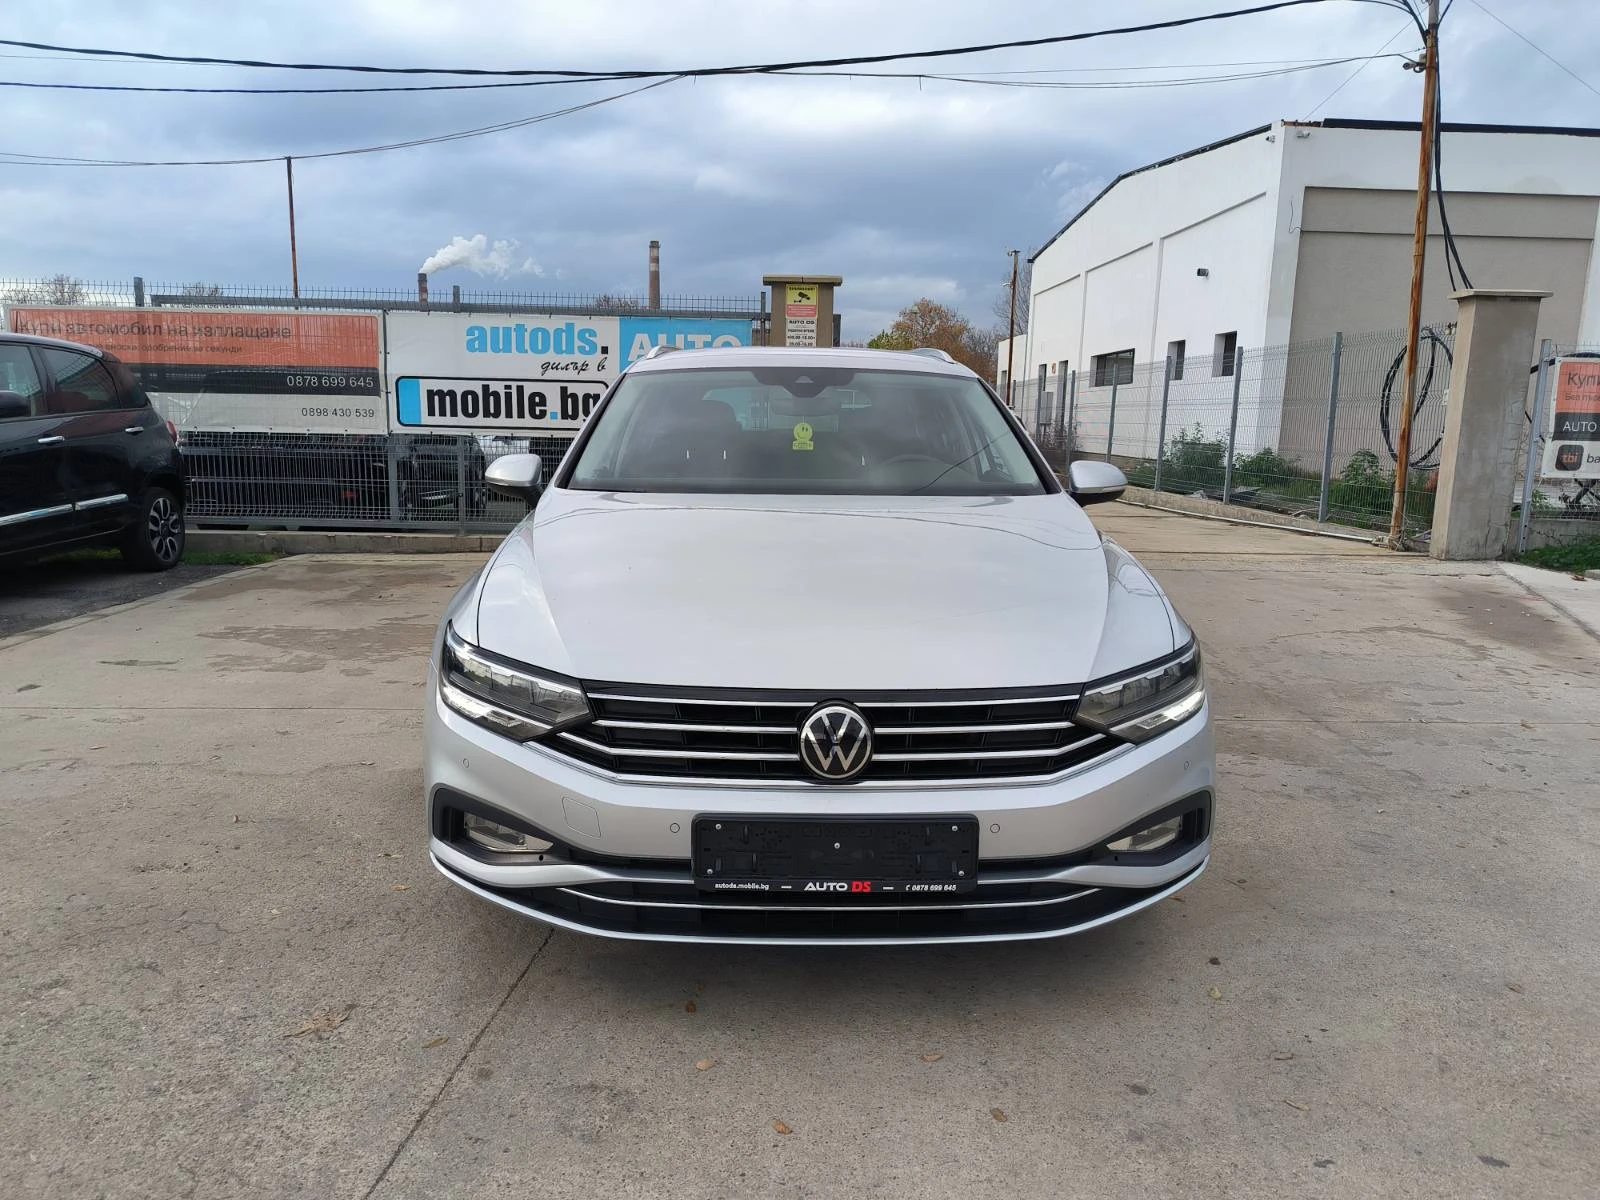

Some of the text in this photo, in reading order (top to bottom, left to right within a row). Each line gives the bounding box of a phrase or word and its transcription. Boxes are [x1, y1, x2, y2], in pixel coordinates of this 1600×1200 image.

[65, 321, 163, 338] автомобил
[167, 325, 188, 337] на
[193, 325, 291, 340] изплащане
[466, 322, 609, 356] autods.
[541, 361, 589, 377] дилър
[286, 375, 374, 388] 0878 699 645
[301, 407, 375, 418] 0898 430 539
[1562, 421, 1598, 433] AUTO
[1561, 452, 1579, 464] tbi
[803, 881, 848, 891] AUTO
[851, 881, 872, 893] DS
